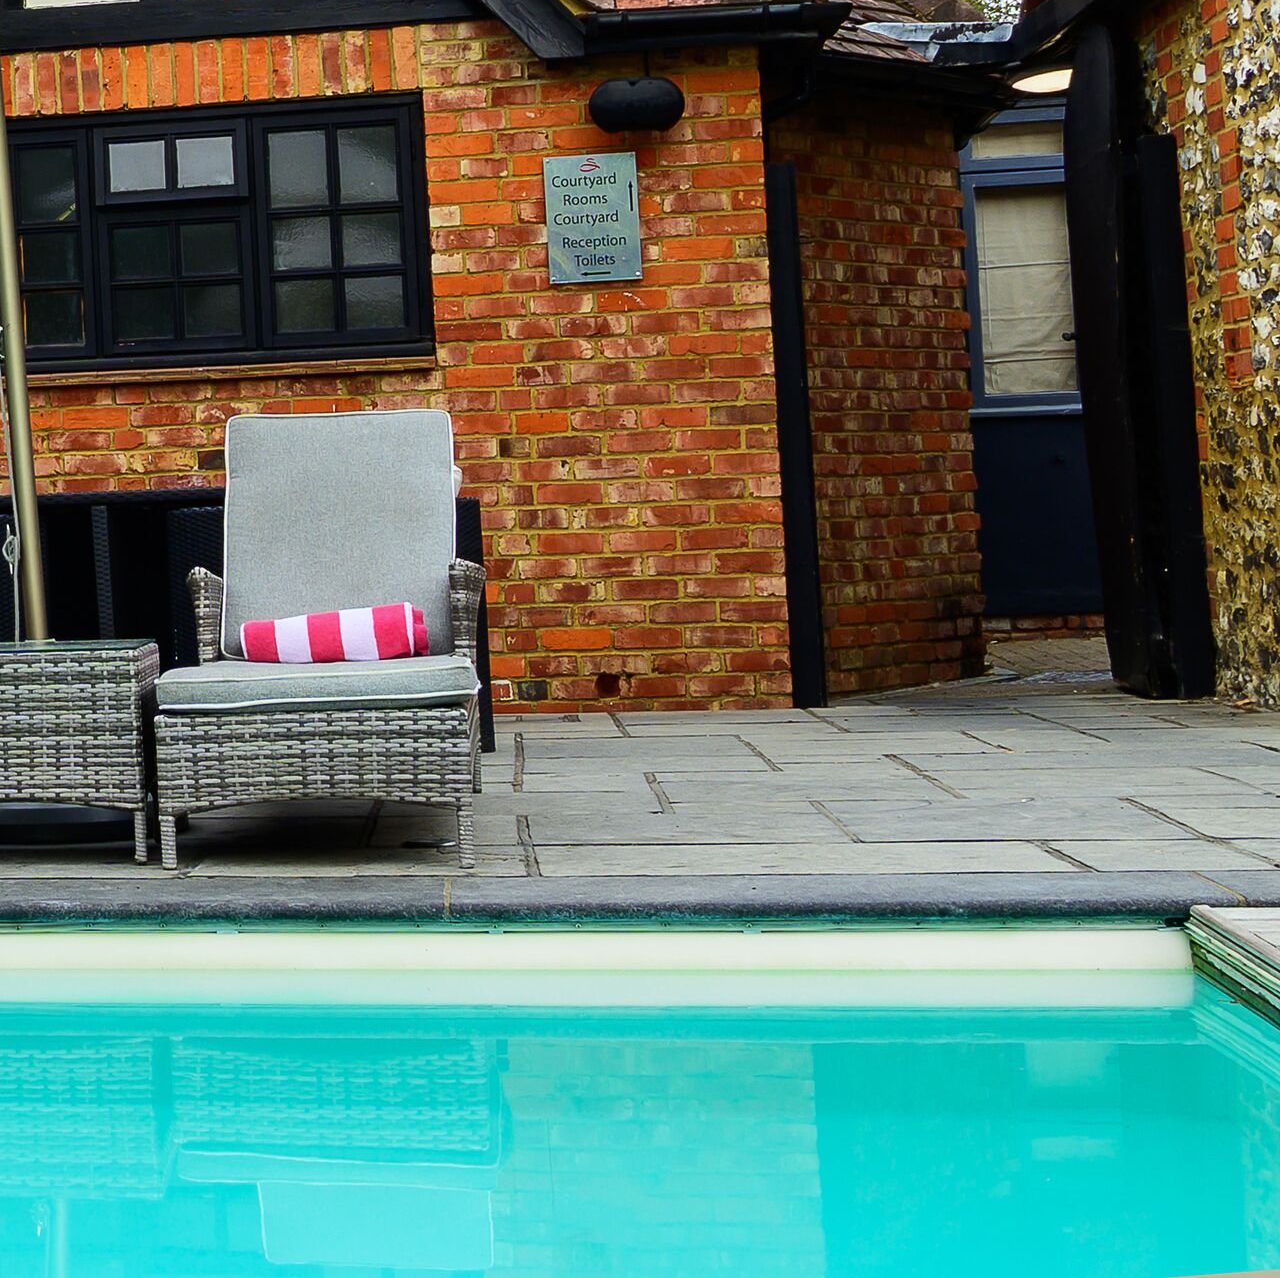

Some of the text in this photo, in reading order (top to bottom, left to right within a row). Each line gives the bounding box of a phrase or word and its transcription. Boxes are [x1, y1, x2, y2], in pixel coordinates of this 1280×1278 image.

[551, 172, 617, 189] Courtyard
[563, 194, 608, 206] Rooms
[553, 210, 619, 227] Courtyard
[562, 234, 627, 250] Reception
[574, 254, 616, 267] Toilets
